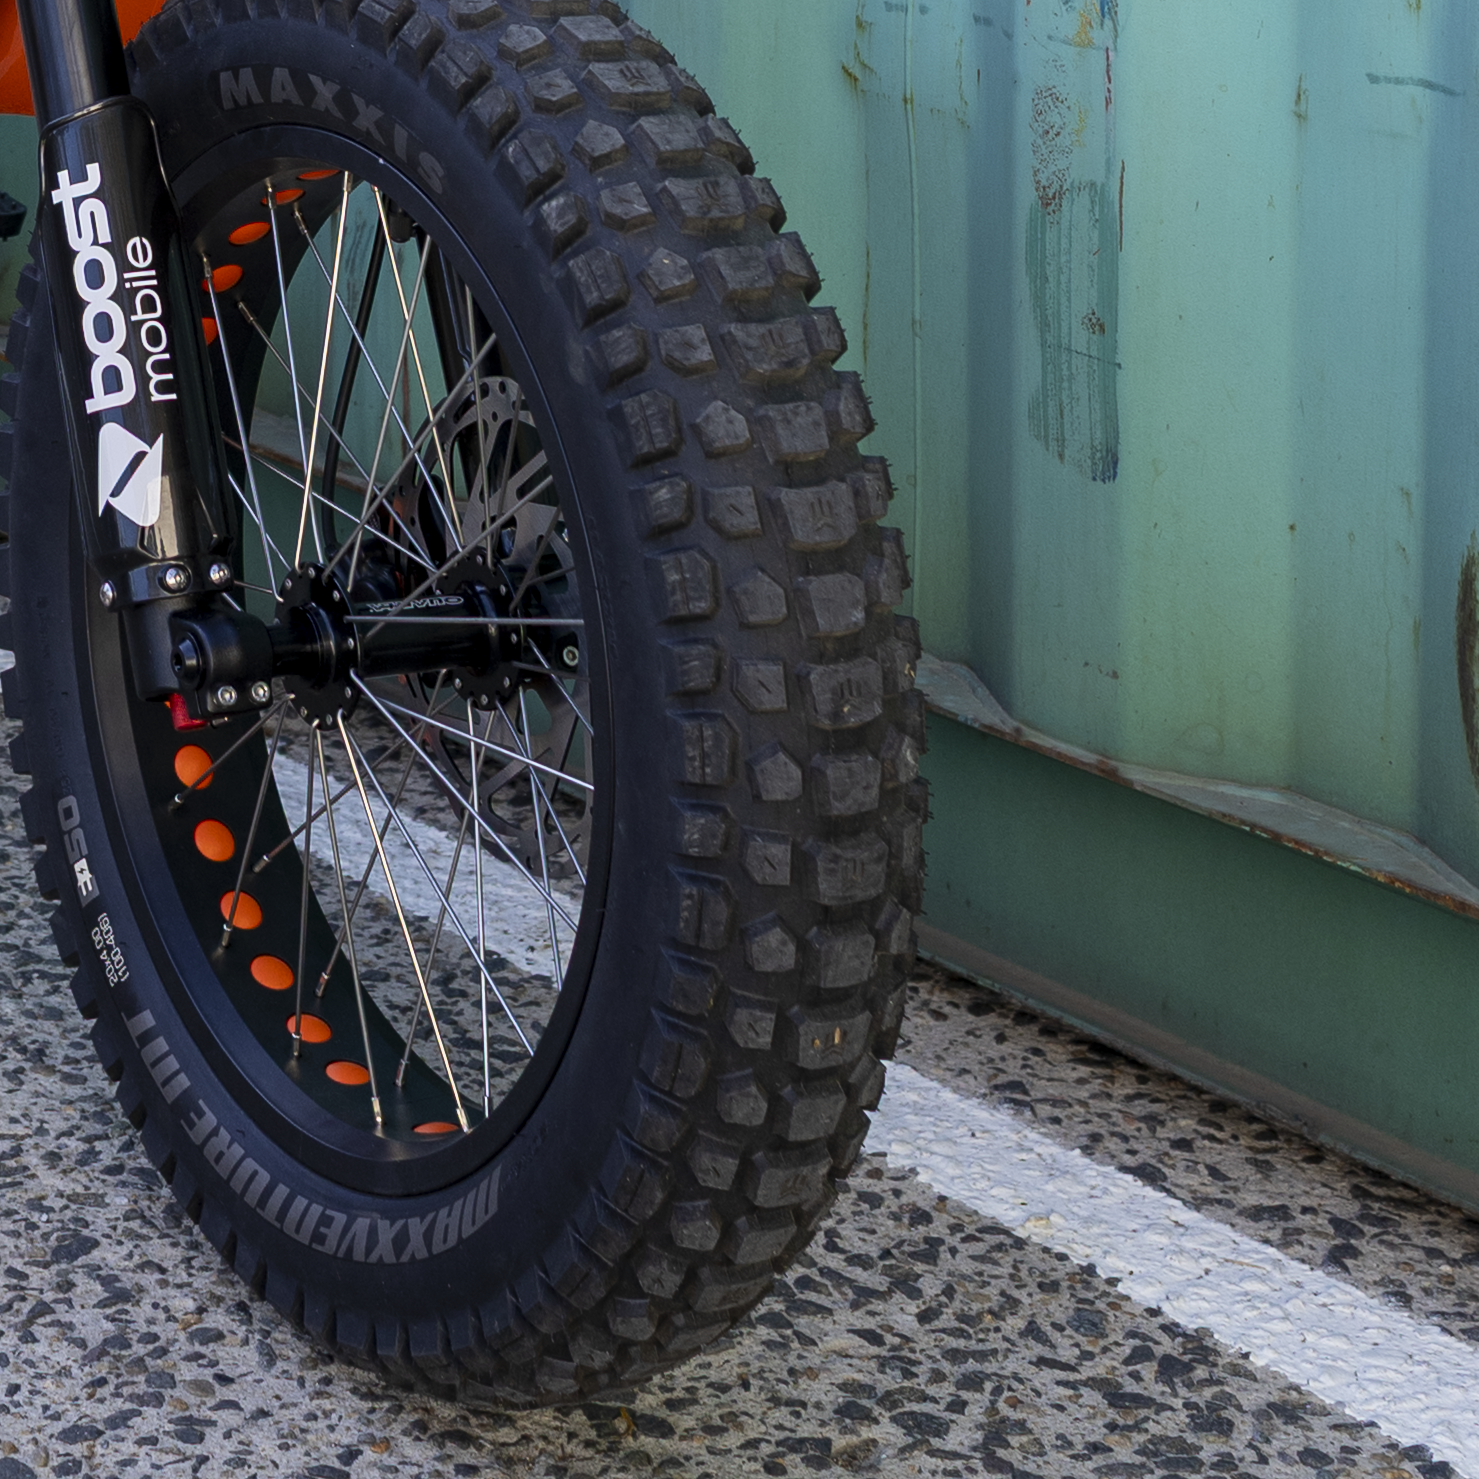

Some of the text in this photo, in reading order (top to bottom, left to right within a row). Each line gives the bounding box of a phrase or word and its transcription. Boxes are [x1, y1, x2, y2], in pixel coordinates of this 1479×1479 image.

[220, 67, 445, 195] MAXXIS
[51, 162, 137, 414] boost
[123, 236, 177, 401] mobile
[97, 912, 129, 983] (100-406)
[181, 1098, 502, 1264] MAXXVENTURE
